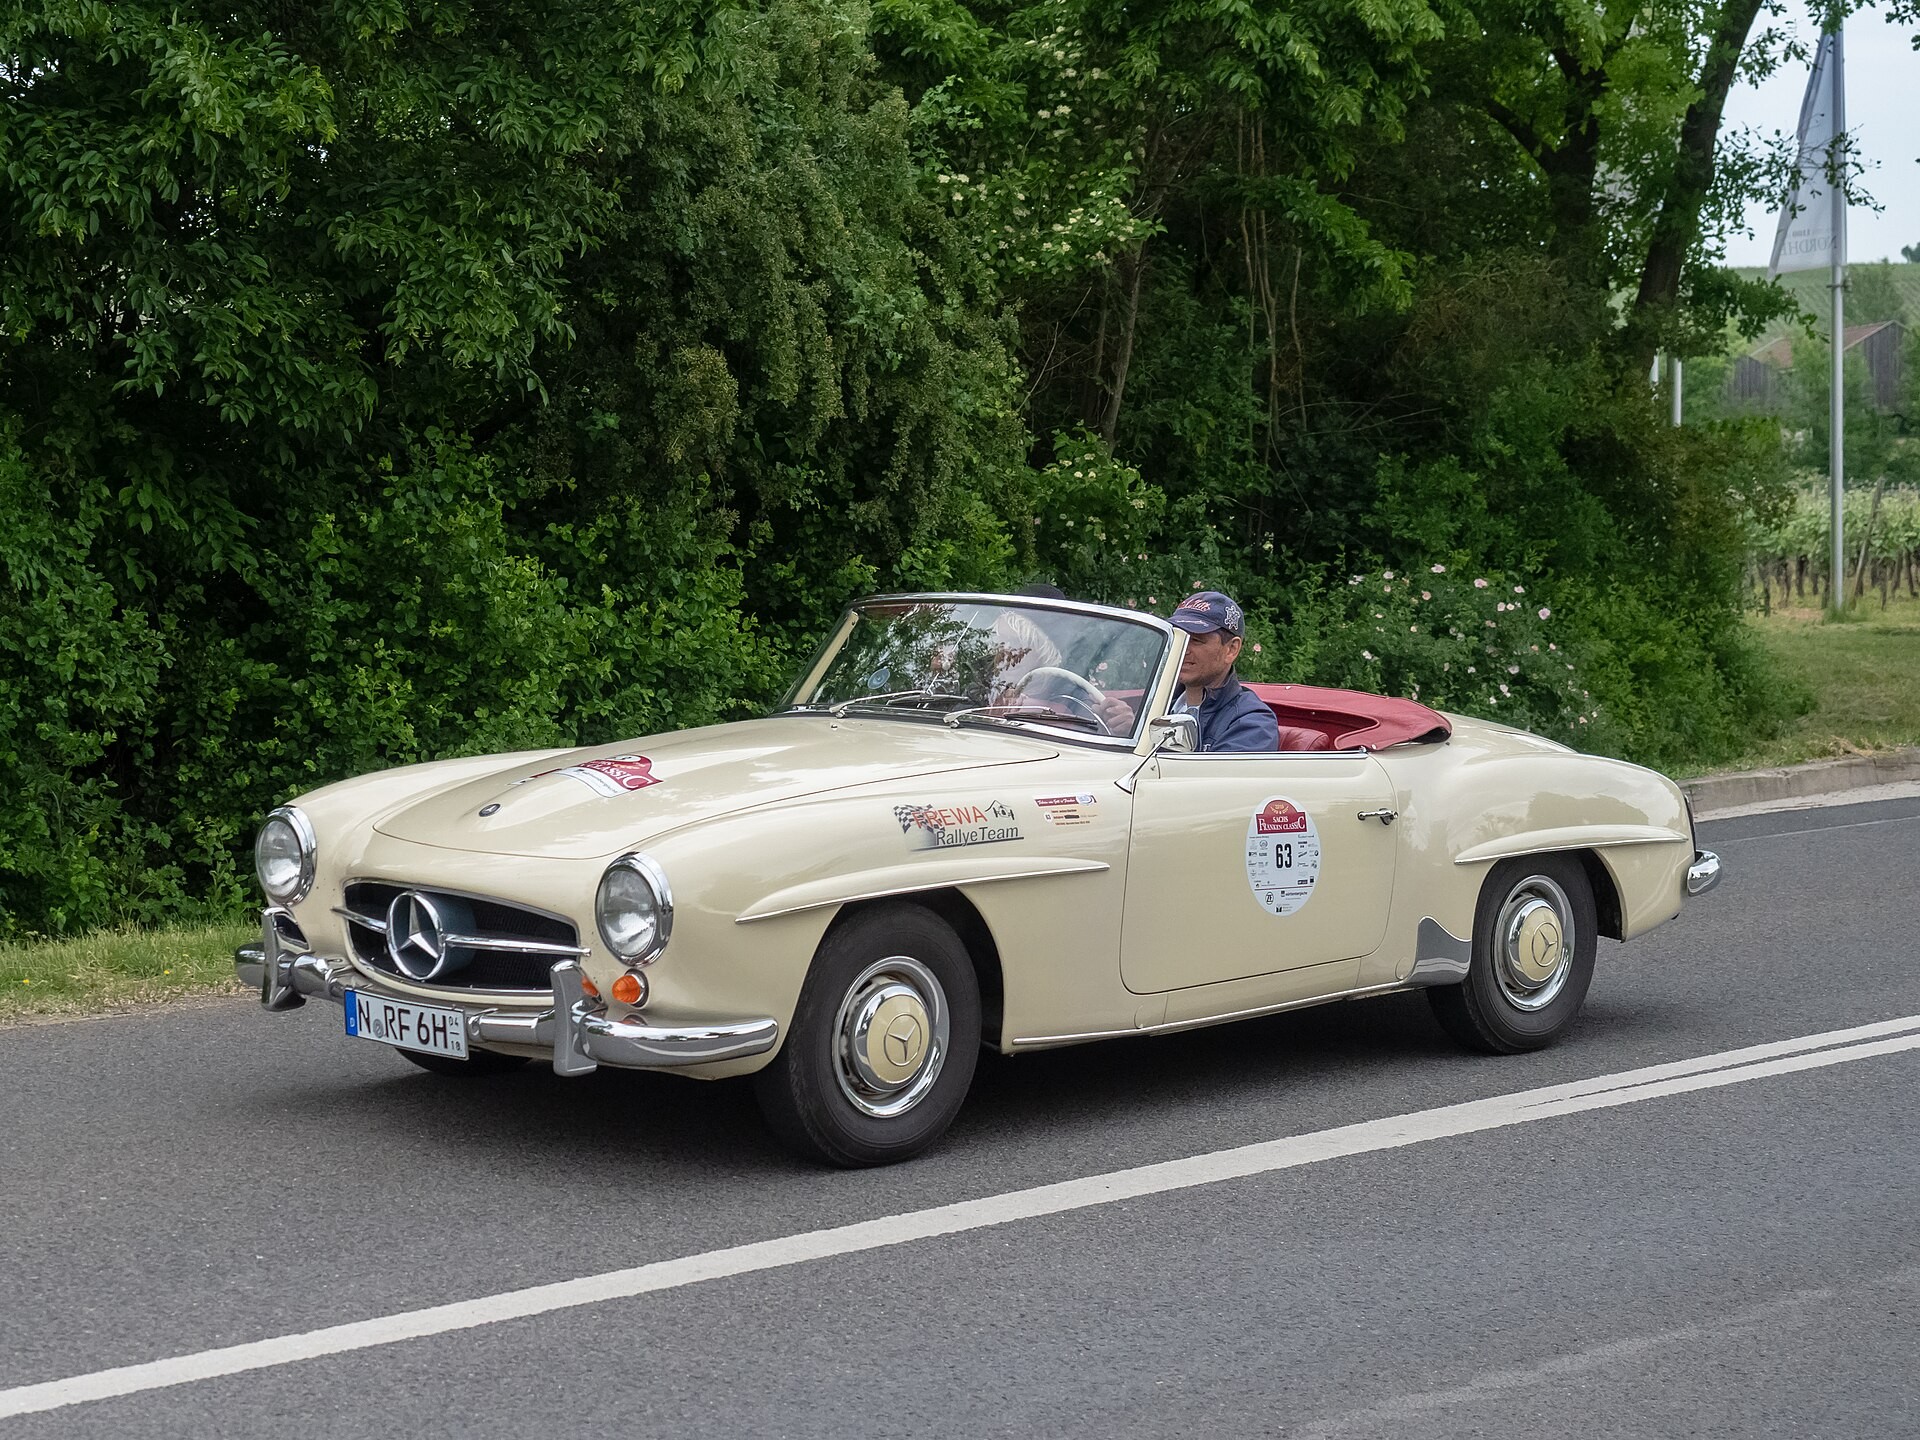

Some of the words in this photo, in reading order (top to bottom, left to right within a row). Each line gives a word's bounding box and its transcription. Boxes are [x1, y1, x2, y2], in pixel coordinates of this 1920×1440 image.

[912, 805, 988, 829] FREWA
[1258, 818, 1283, 831] FRANKEN
[1283, 816, 1305, 830] CLASSIC
[1275, 843, 1293, 869] 63
[357, 998, 372, 1034] N
[384, 1004, 411, 1042] RF
[416, 1011, 449, 1049] 6H
